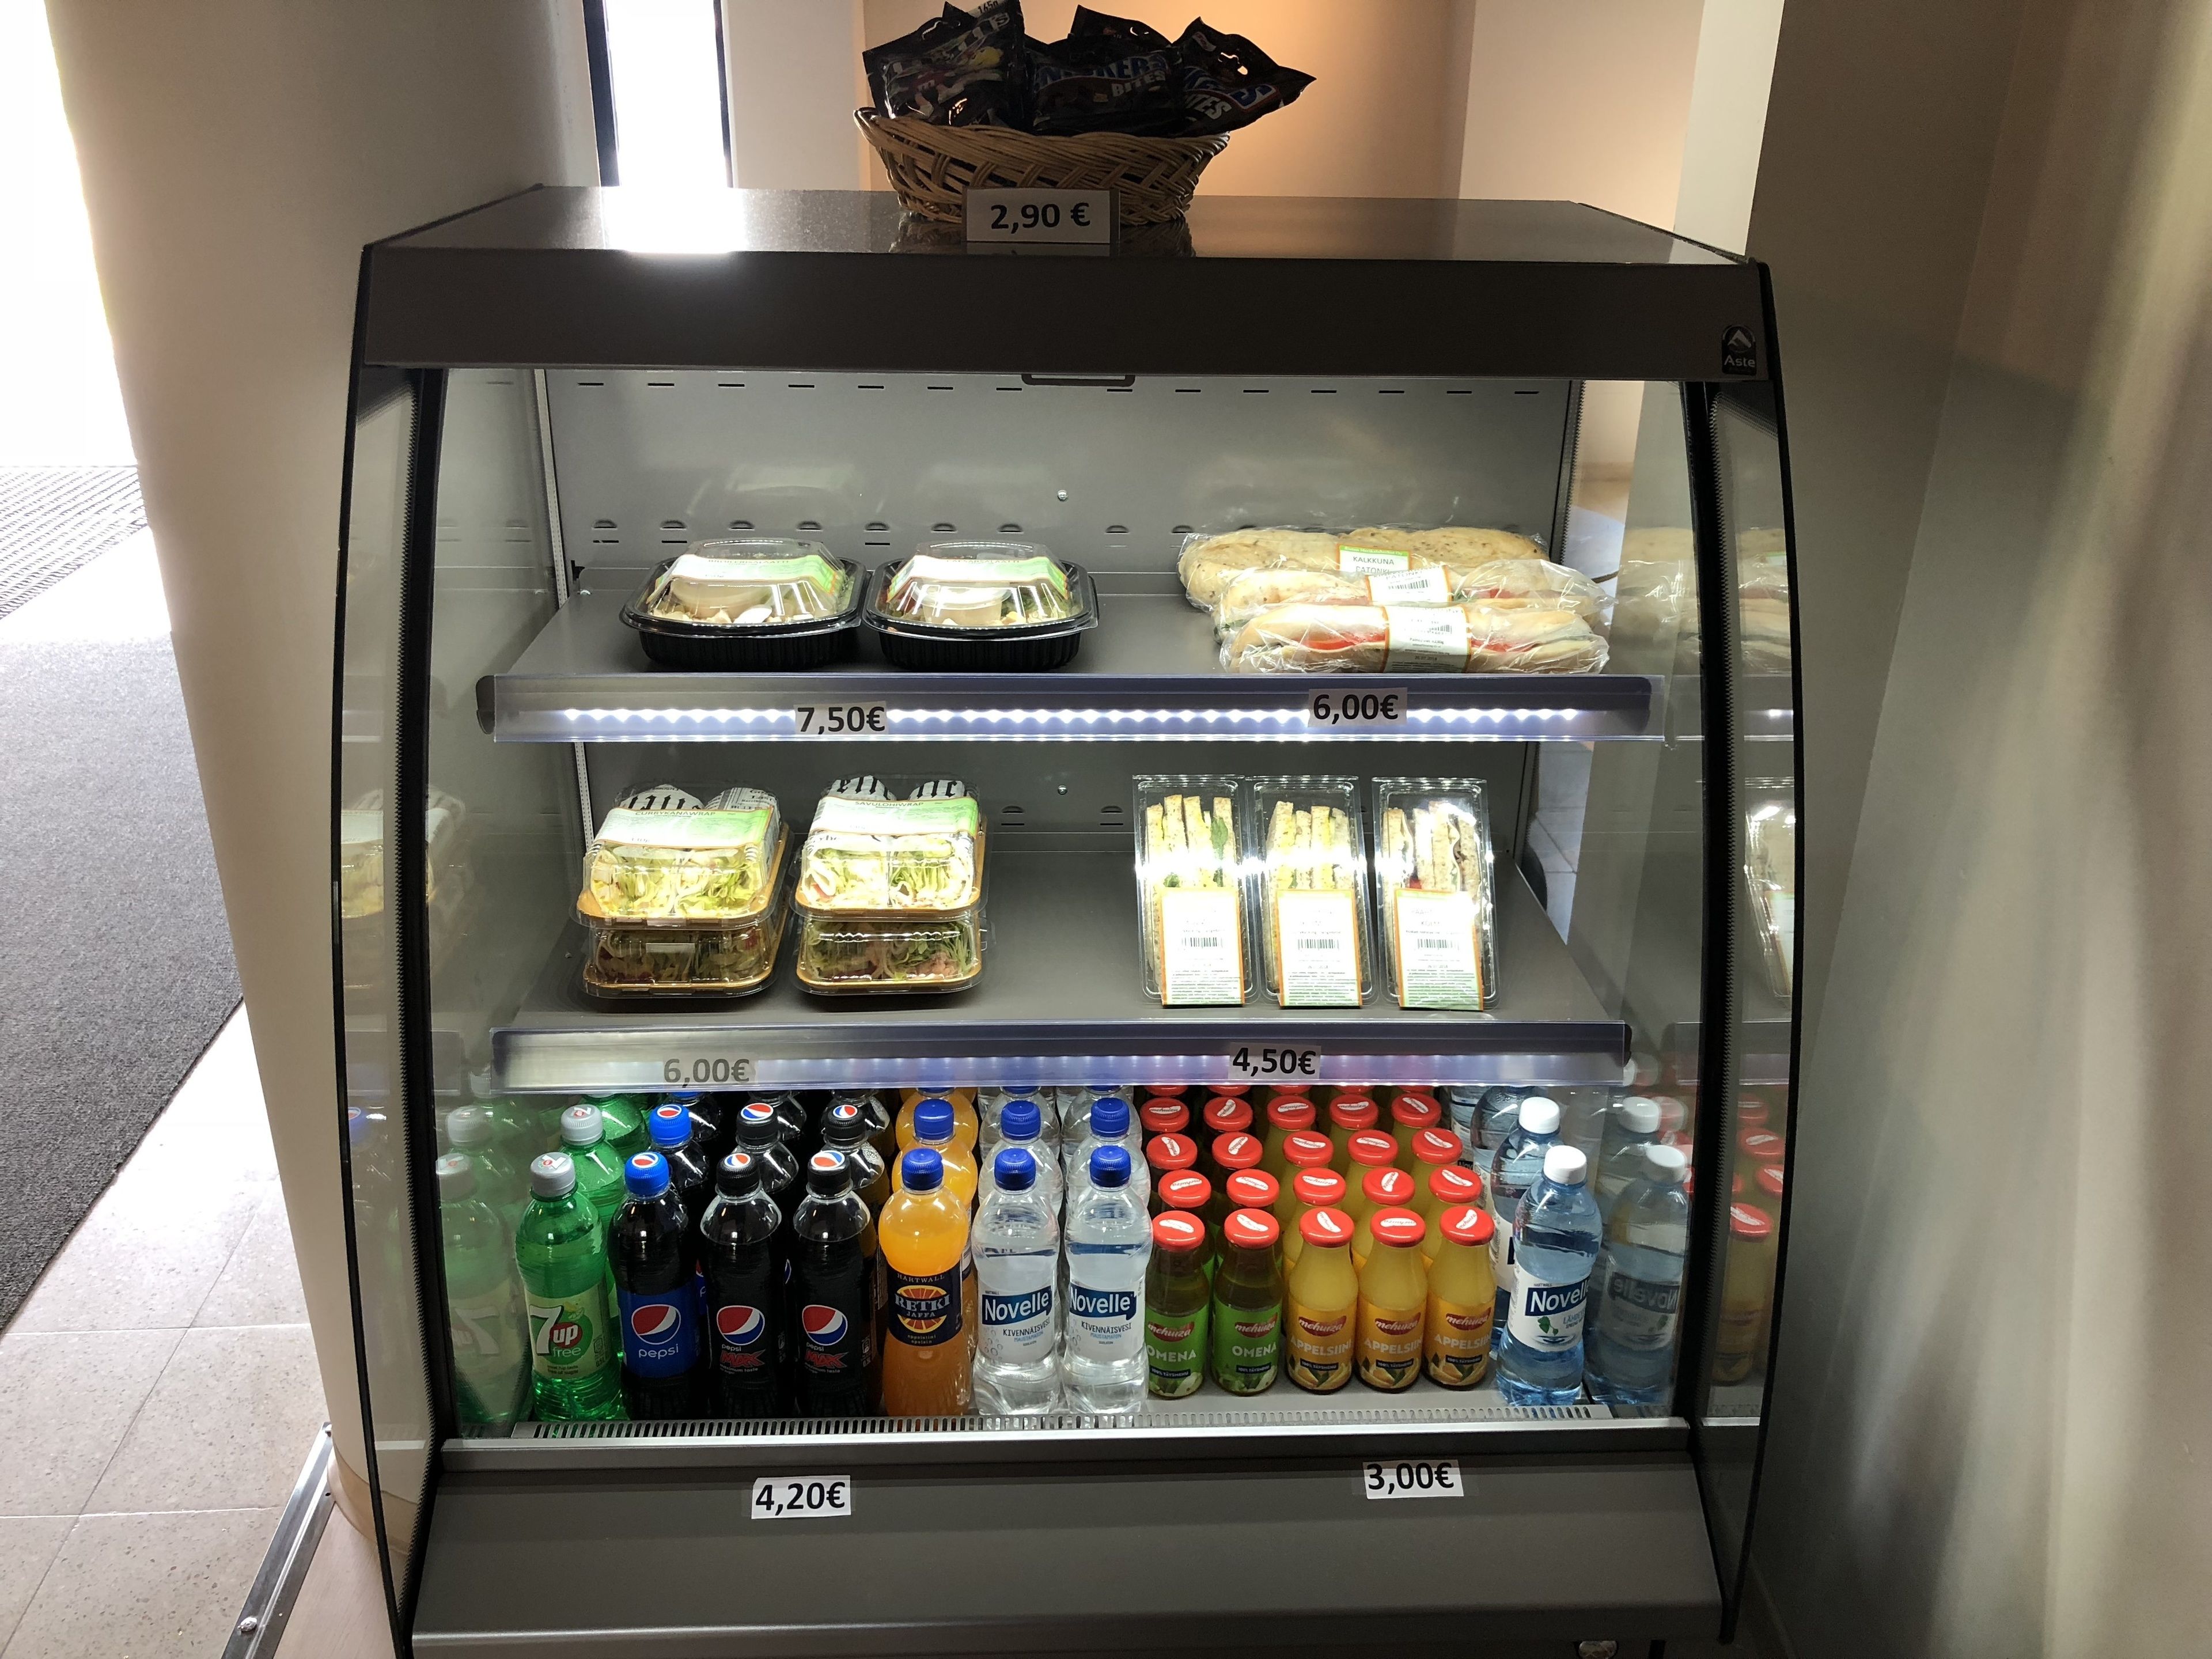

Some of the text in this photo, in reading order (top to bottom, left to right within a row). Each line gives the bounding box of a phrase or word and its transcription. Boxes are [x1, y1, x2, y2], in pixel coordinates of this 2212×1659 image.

[991, 203, 1091, 234] 2,90 €
[1724, 354, 1756, 368] Aste
[1353, 556, 1395, 565] KALKKUNA
[1313, 692, 1399, 726] 6,00€
[797, 706, 885, 736] 7,50€
[1232, 1047, 1316, 1078] 4,50€
[663, 1058, 750, 1088] 6,00€
[897, 1272, 945, 1283] HARTWALL
[894, 1293, 950, 1312] RETKI
[985, 1291, 1049, 1321] Novelle
[1070, 1286, 1131, 1313] Novelle
[1003, 1317, 1050, 1336] KIVENNÄISVESI
[1081, 1320, 1132, 1334] KIVENNÄISVESI
[552, 1346, 582, 1358] free
[638, 1343, 679, 1360] pepsi
[721, 1344, 742, 1352] pepsi
[1147, 1344, 1196, 1362] OMENA
[1232, 1342, 1277, 1358] OMENA
[719, 1349, 767, 1369] MAX
[1368, 1463, 1455, 1497] 3,00€
[755, 1482, 846, 1516] 4,20€
